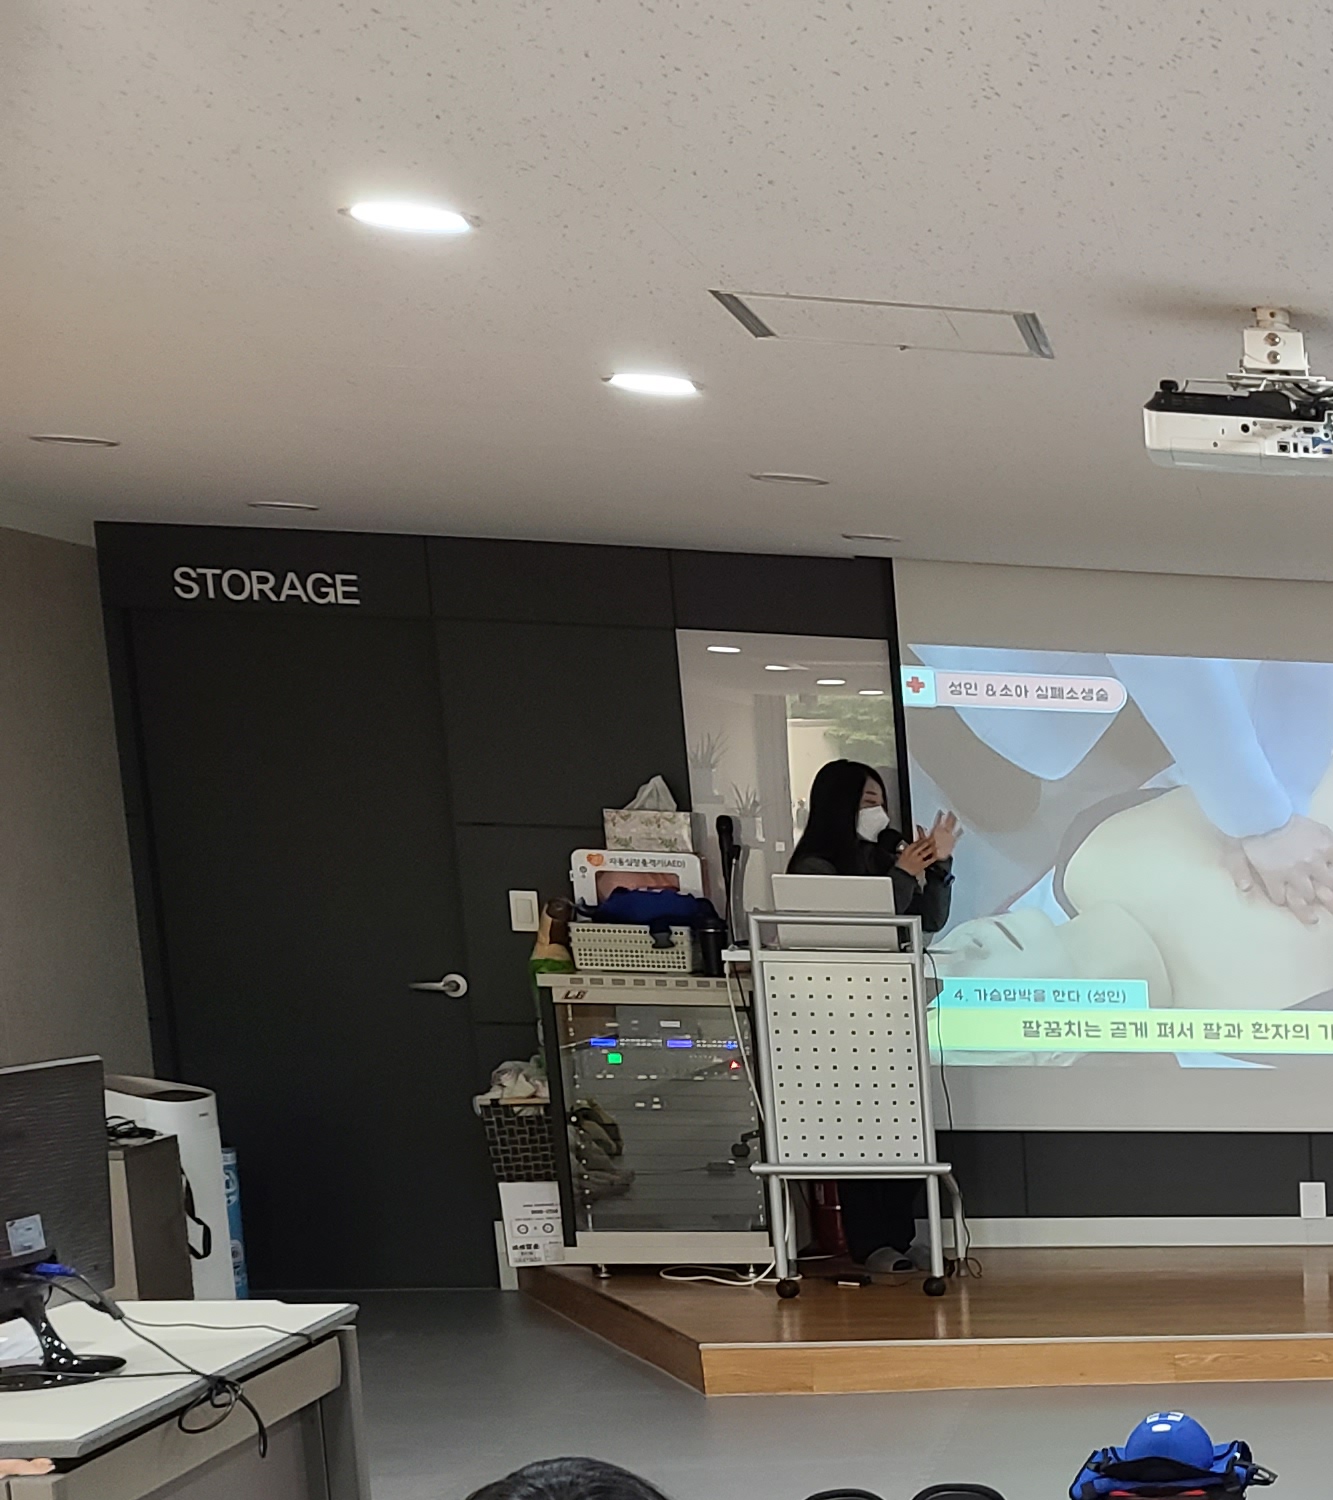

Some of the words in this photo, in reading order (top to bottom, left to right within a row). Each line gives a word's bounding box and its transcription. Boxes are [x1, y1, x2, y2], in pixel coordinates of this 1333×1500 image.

[173, 566, 361, 605] STORAGE
[948, 681, 978, 697] 성인
[1035, 685, 1109, 702] 심폐소생술
[954, 989, 969, 1002] 4.
[974, 988, 1046, 1003] 가슴압박을
[1052, 989, 1081, 1003] 한다
[1087, 989, 1127, 1004] (성인)
[1021, 1019, 1103, 1039] 팔꿈치는
[1109, 1020, 1149, 1039] 곧게
[1156, 1021, 1194, 1039] 펴서
[1202, 1021, 1244, 1040] 팔과
[1251, 1021, 1310, 1041] 환자의
